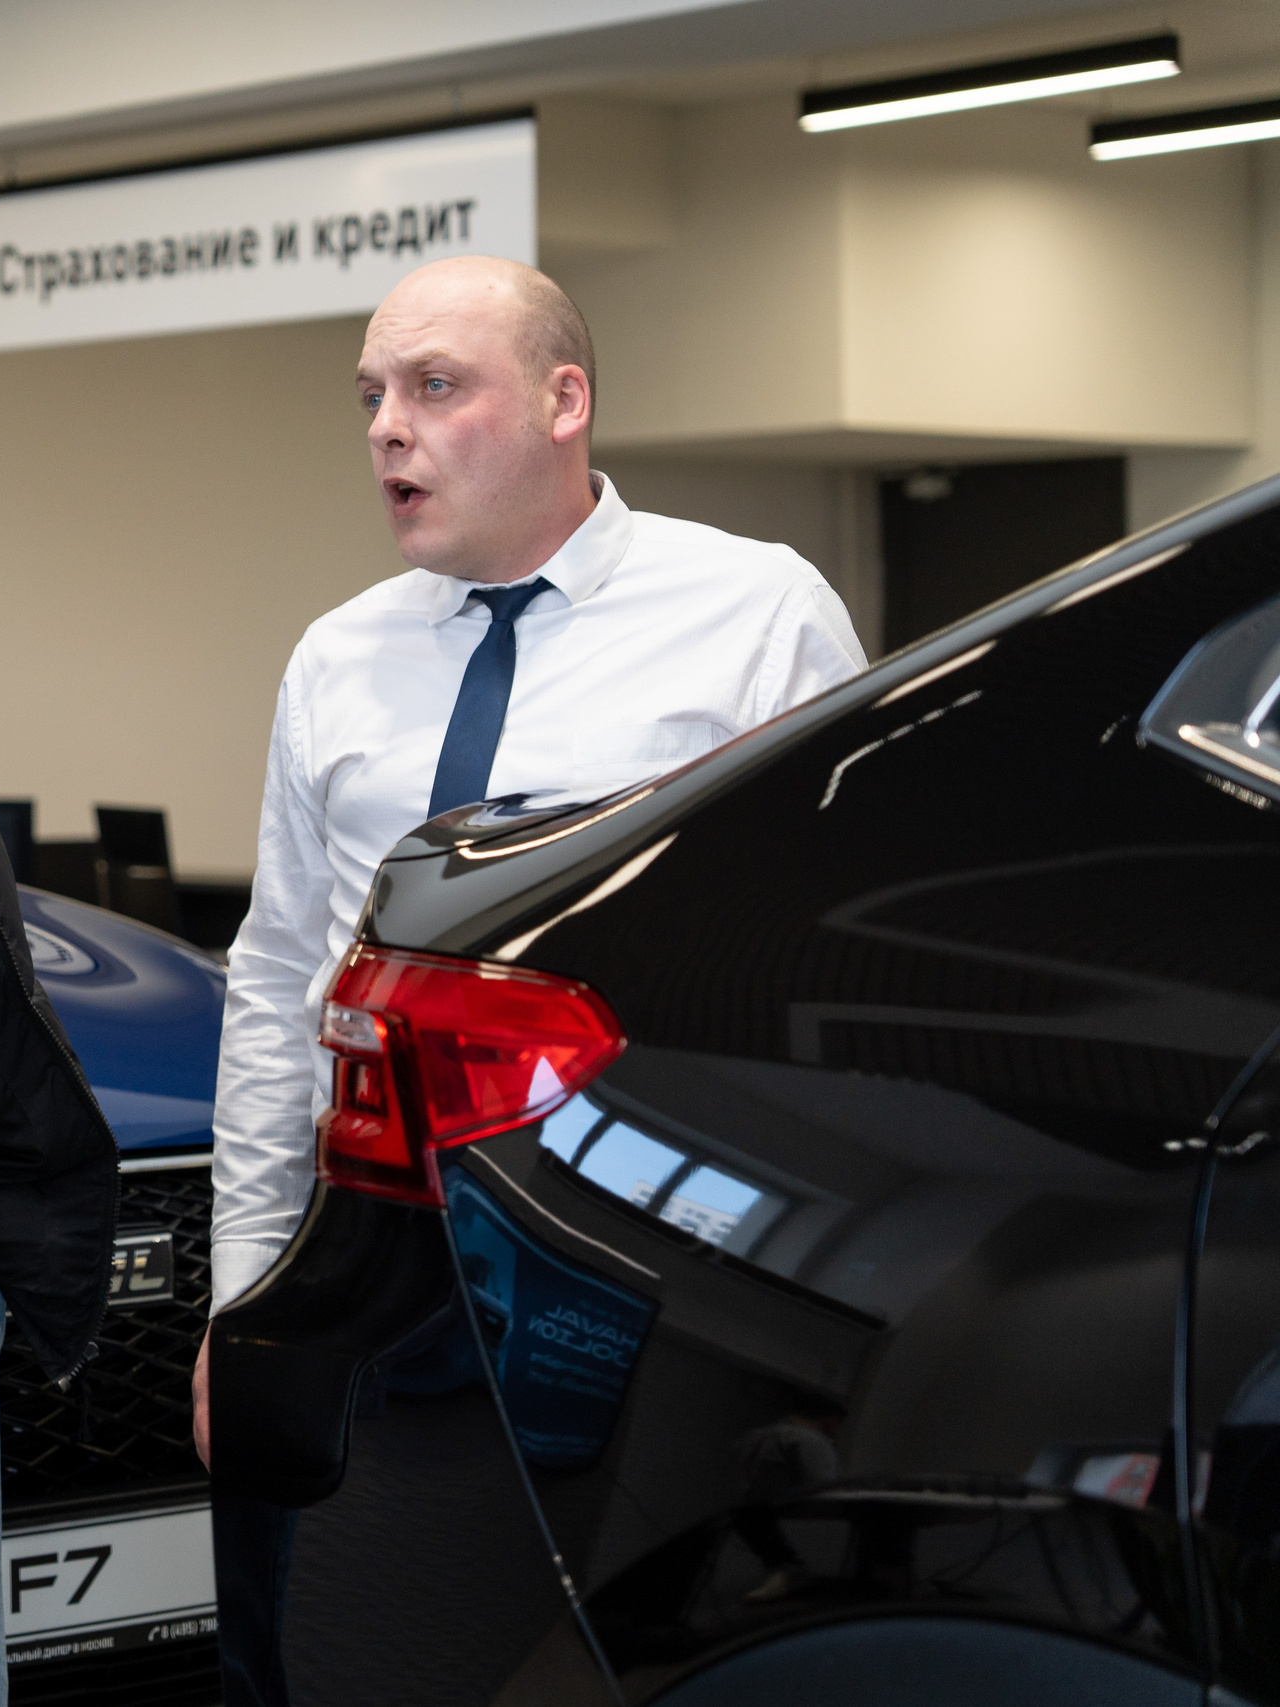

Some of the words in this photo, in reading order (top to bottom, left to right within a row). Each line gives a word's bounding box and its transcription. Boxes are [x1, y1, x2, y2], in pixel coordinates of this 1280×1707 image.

[273, 219, 299, 264] и
[313, 197, 478, 269] кредит
[10, 1544, 113, 1614] F7
